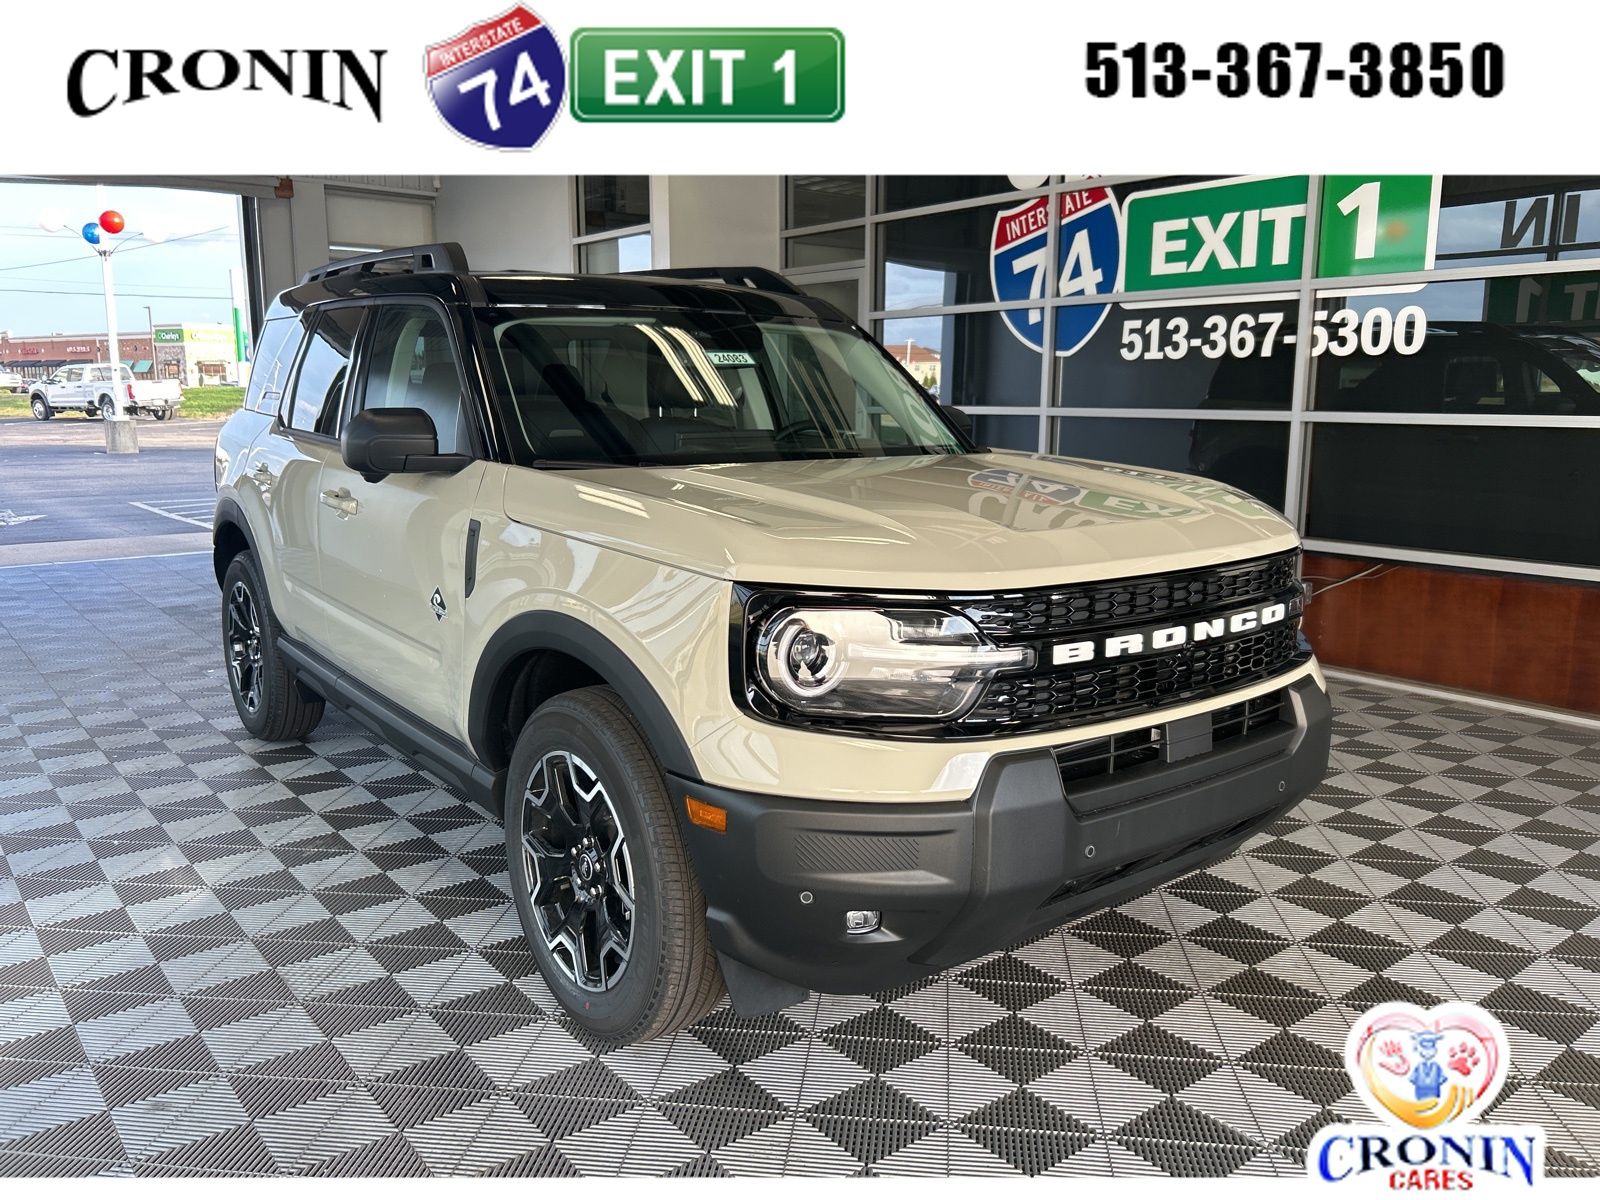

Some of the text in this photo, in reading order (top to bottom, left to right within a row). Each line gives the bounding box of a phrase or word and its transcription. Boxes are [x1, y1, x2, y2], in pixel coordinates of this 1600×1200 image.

[1005, 188, 1093, 241] INTERATE
[1151, 181, 1381, 276] EXIT 1
[1011, 228, 1104, 325] 74
[713, 353, 749, 363] 24083
[1052, 603, 1286, 666] BRONCO
